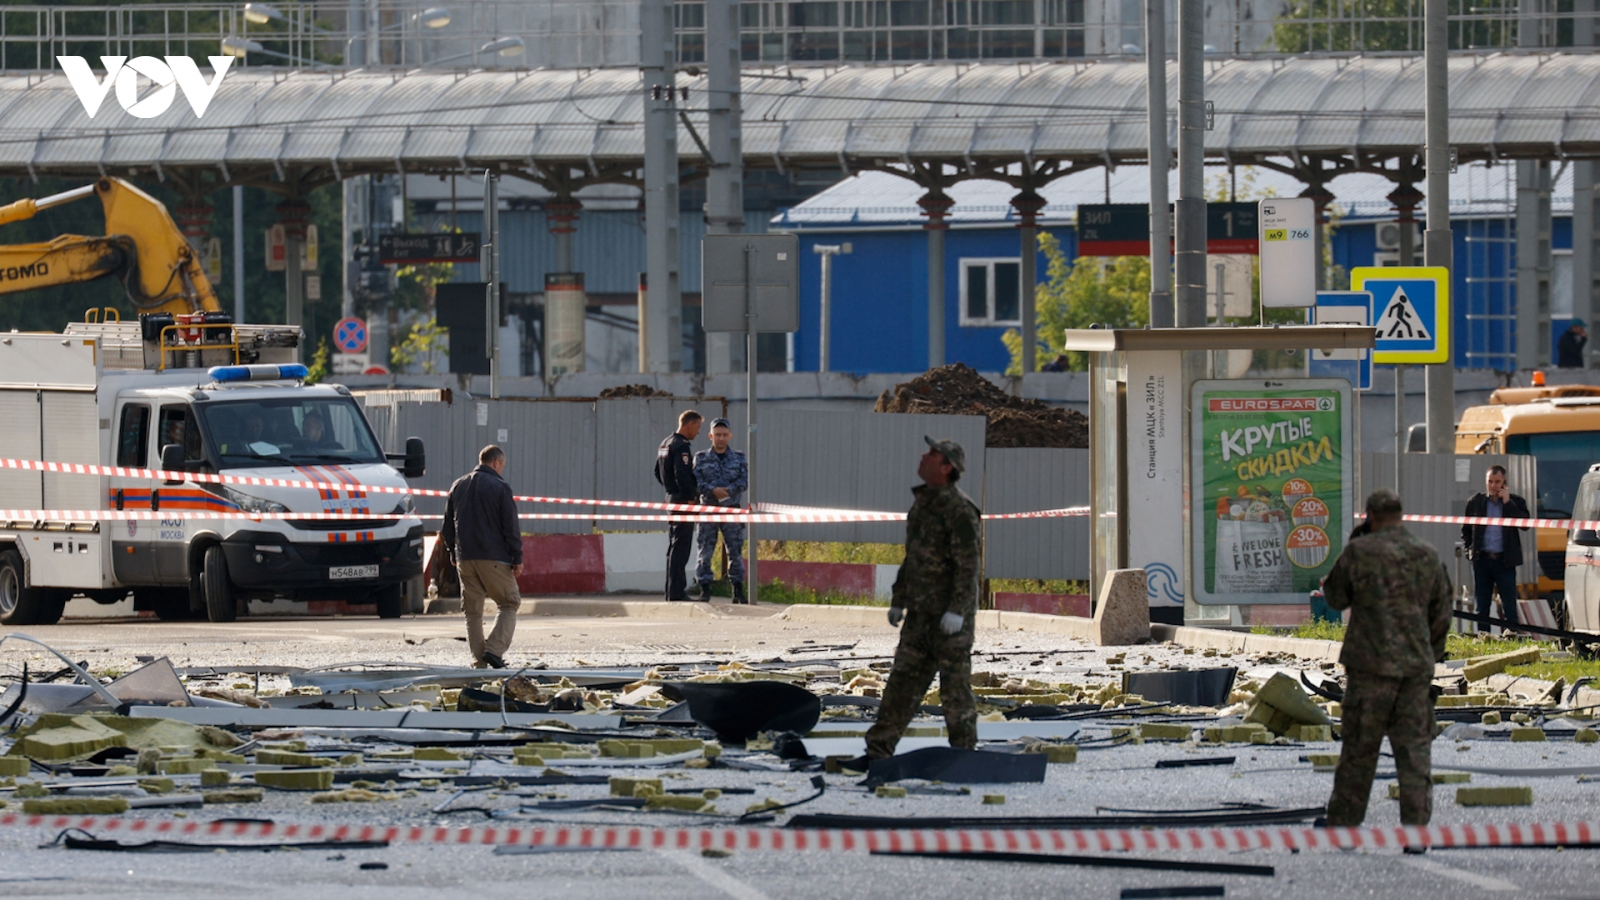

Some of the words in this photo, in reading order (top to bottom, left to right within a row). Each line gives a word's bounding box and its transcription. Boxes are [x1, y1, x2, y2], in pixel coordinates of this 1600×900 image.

[1084, 211, 1111, 224] ЗИЛ
[1223, 211, 1233, 237] 1
[1291, 230, 1309, 239] 766
[1221, 400, 1316, 409] EUROSPAR
[1146, 412, 1156, 437] МЦК
[1221, 417, 1312, 461] КРУТЫЕ
[1147, 440, 1156, 479] Станция
[1237, 436, 1333, 480] СКИДКИ
[1287, 481, 1306, 491] -10%
[323, 499, 370, 509] IVECO
[1297, 500, 1323, 512] -20%
[160, 530, 185, 540] МОСКВА
[1293, 528, 1323, 541] -30%
[1258, 537, 1280, 550] LOVE
